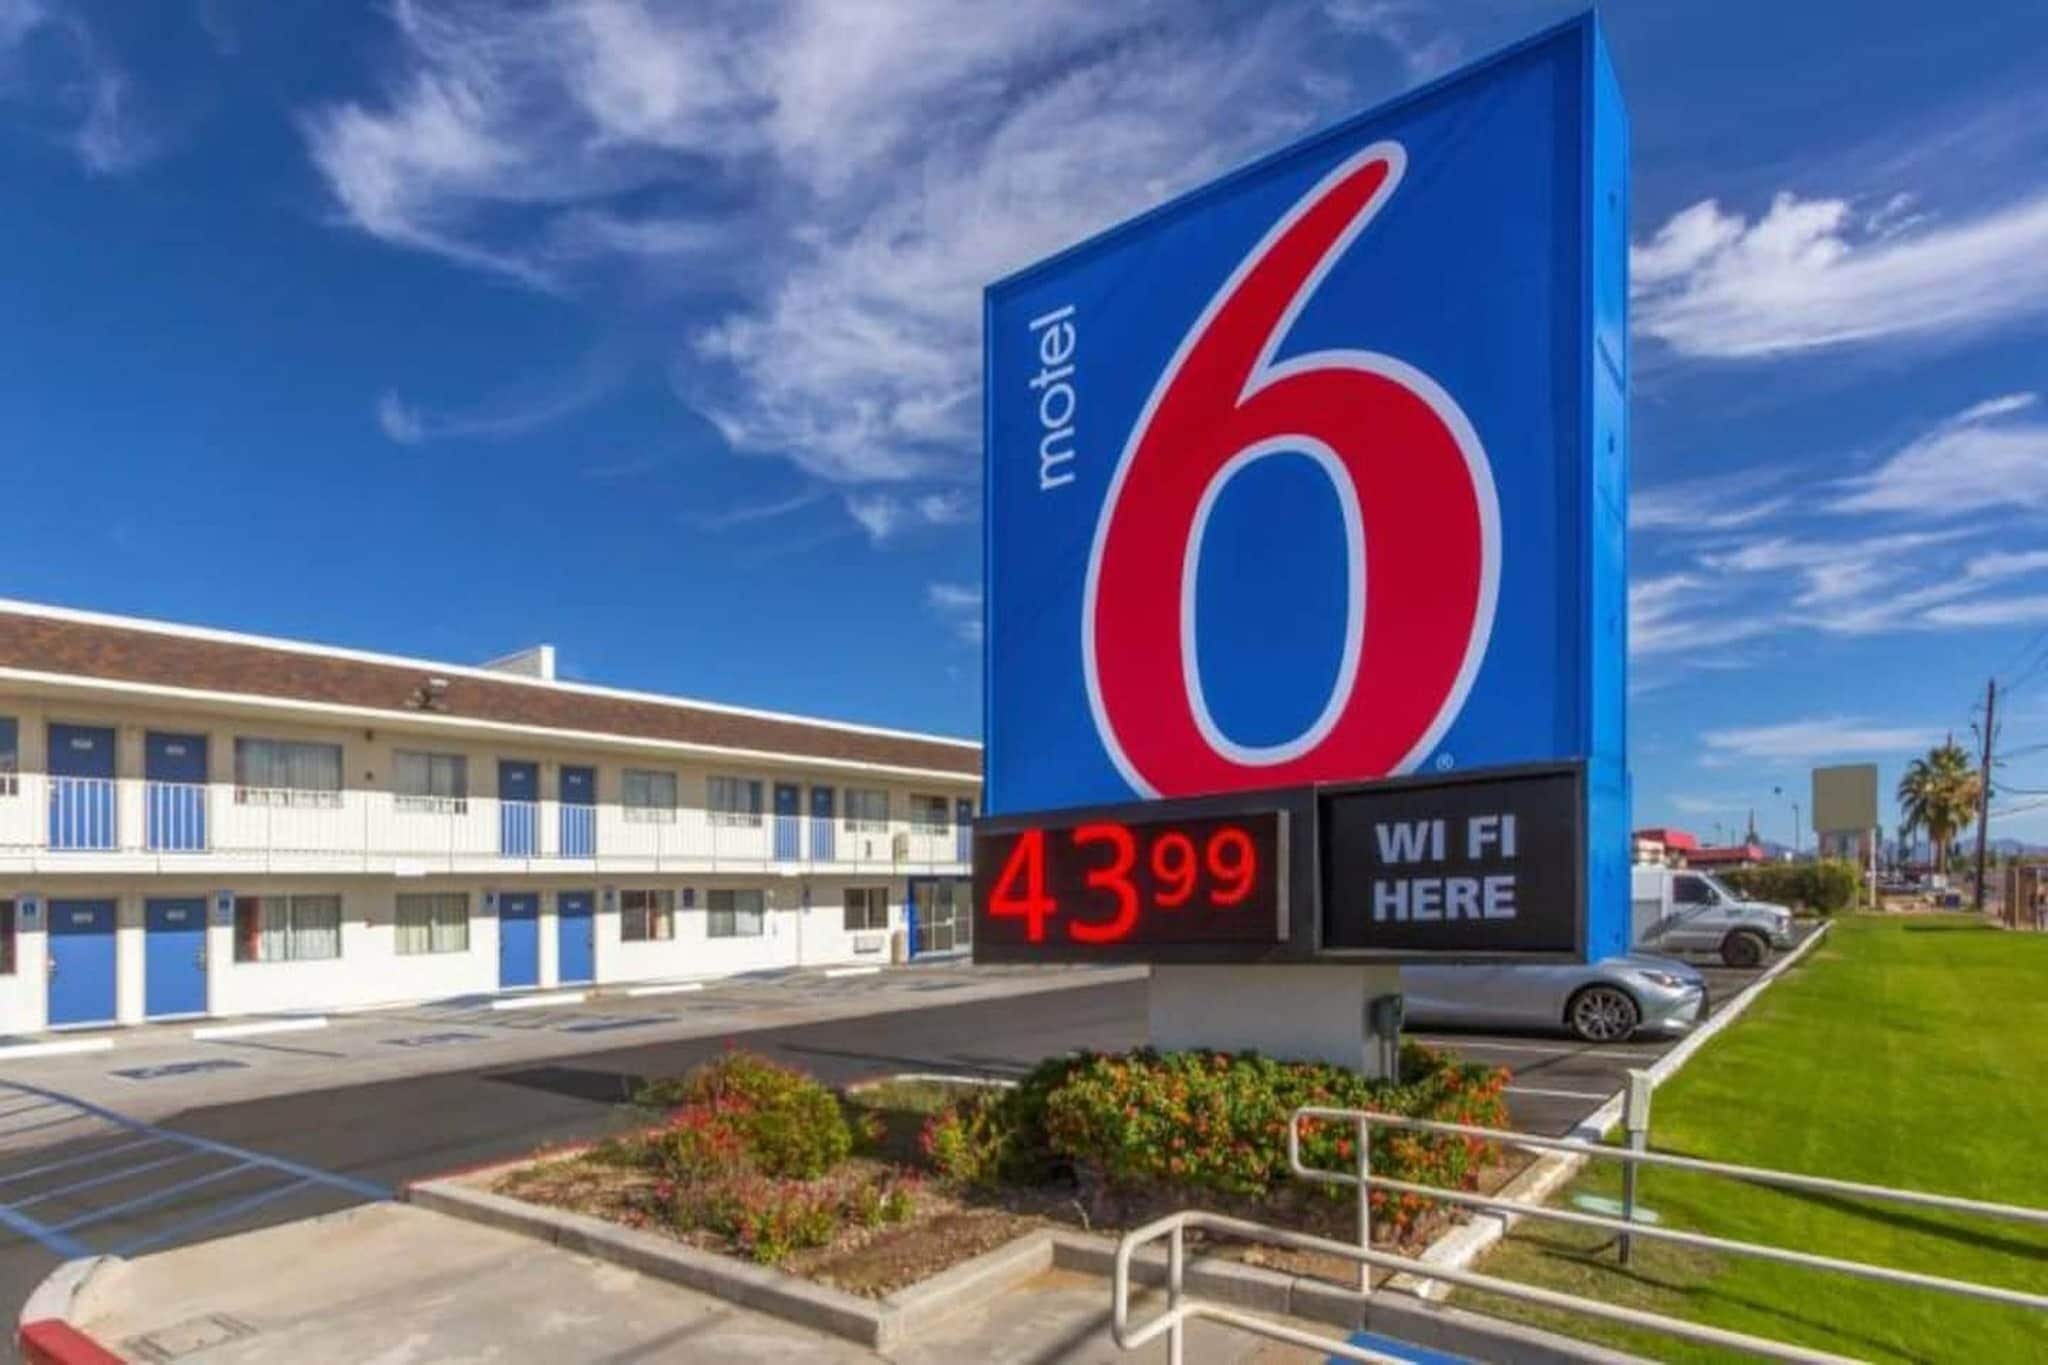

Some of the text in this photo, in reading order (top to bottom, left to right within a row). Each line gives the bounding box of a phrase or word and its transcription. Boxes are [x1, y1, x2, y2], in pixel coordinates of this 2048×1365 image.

[1028, 304, 1077, 491] motel
[1081, 139, 1503, 799] 6
[1373, 874, 1517, 922] HERE
[1375, 814, 1517, 865] WI FI
